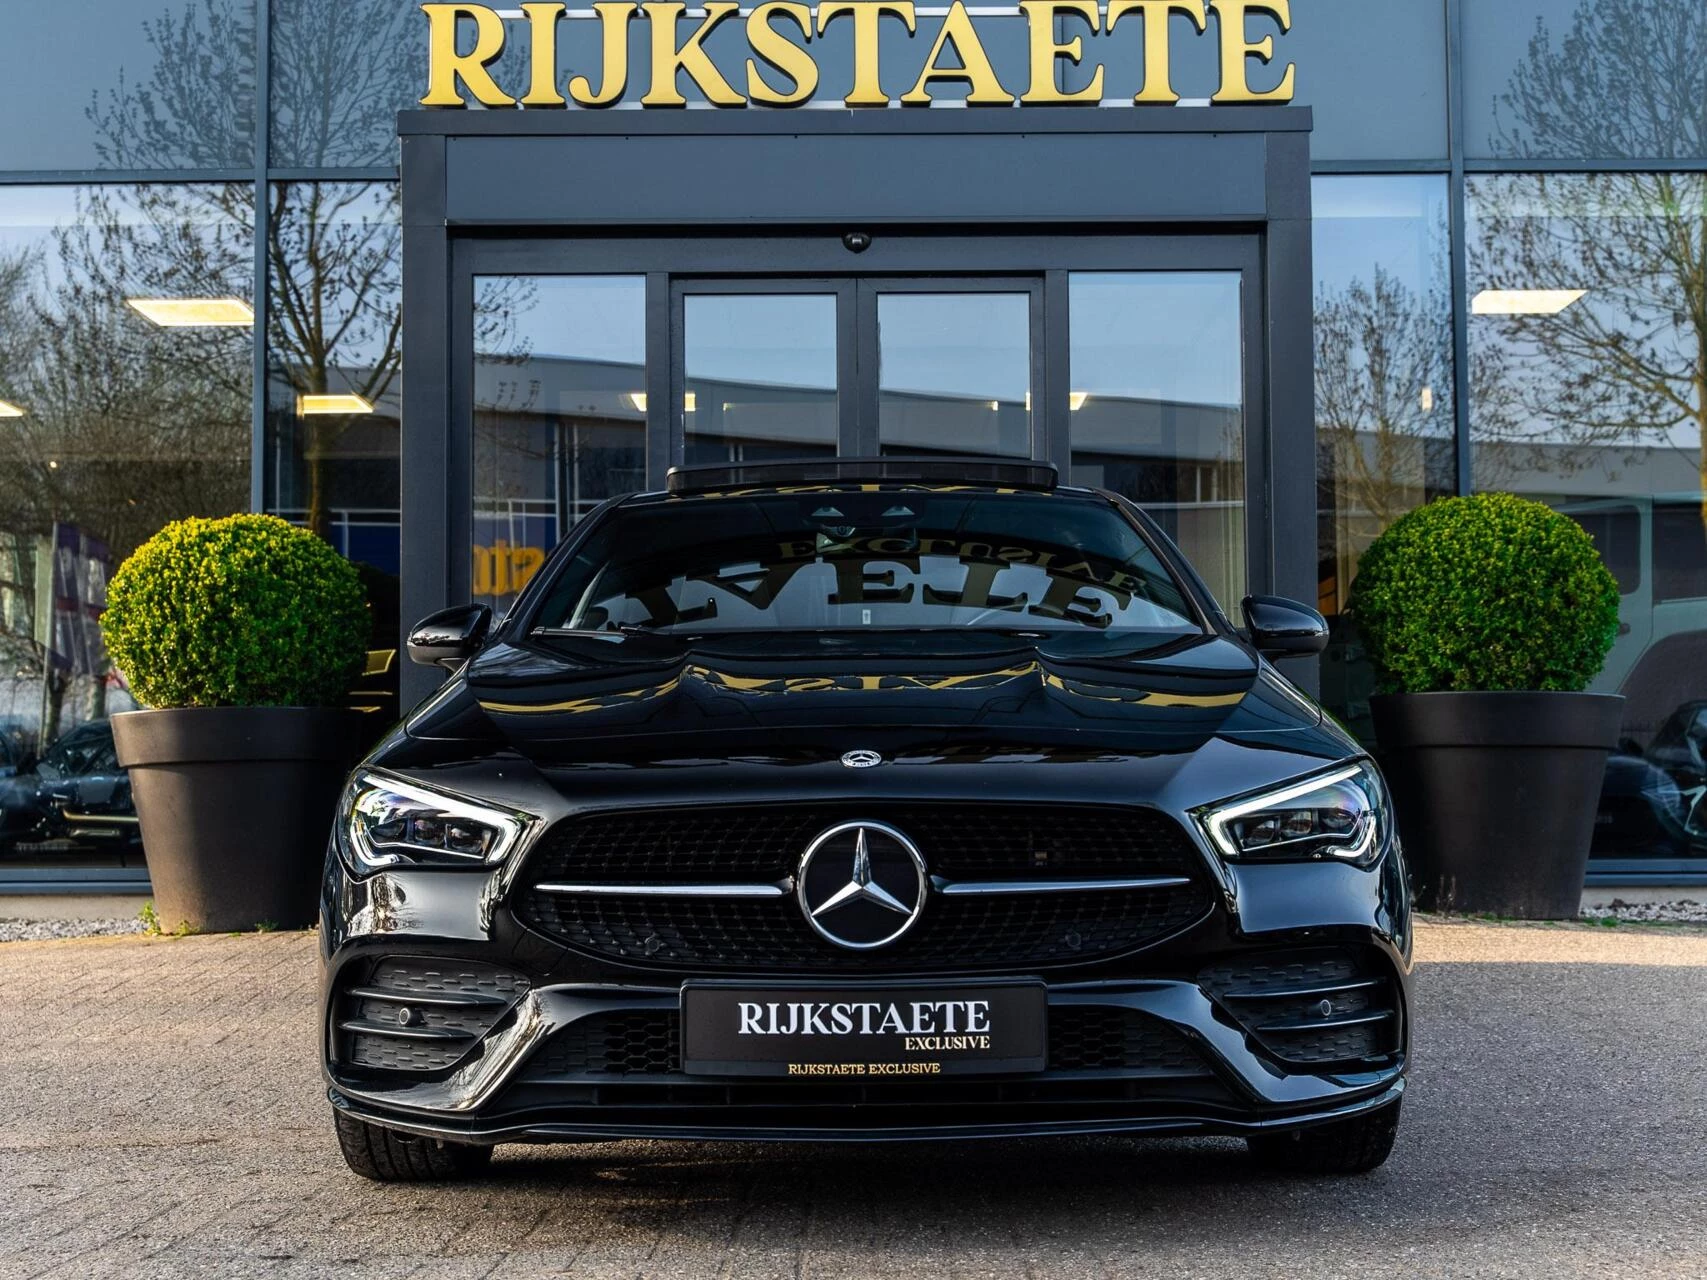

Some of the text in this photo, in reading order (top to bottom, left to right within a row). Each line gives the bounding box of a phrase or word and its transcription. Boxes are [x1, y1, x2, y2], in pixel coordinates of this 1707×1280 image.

[420, 0, 1296, 108] RIJKSTAETE
[738, 1001, 990, 1035] RIJKSTAETE
[904, 1036, 990, 1050] EXCLUSIVE
[788, 1063, 941, 1075] RIJKSTAETE EXCLUSIVE
